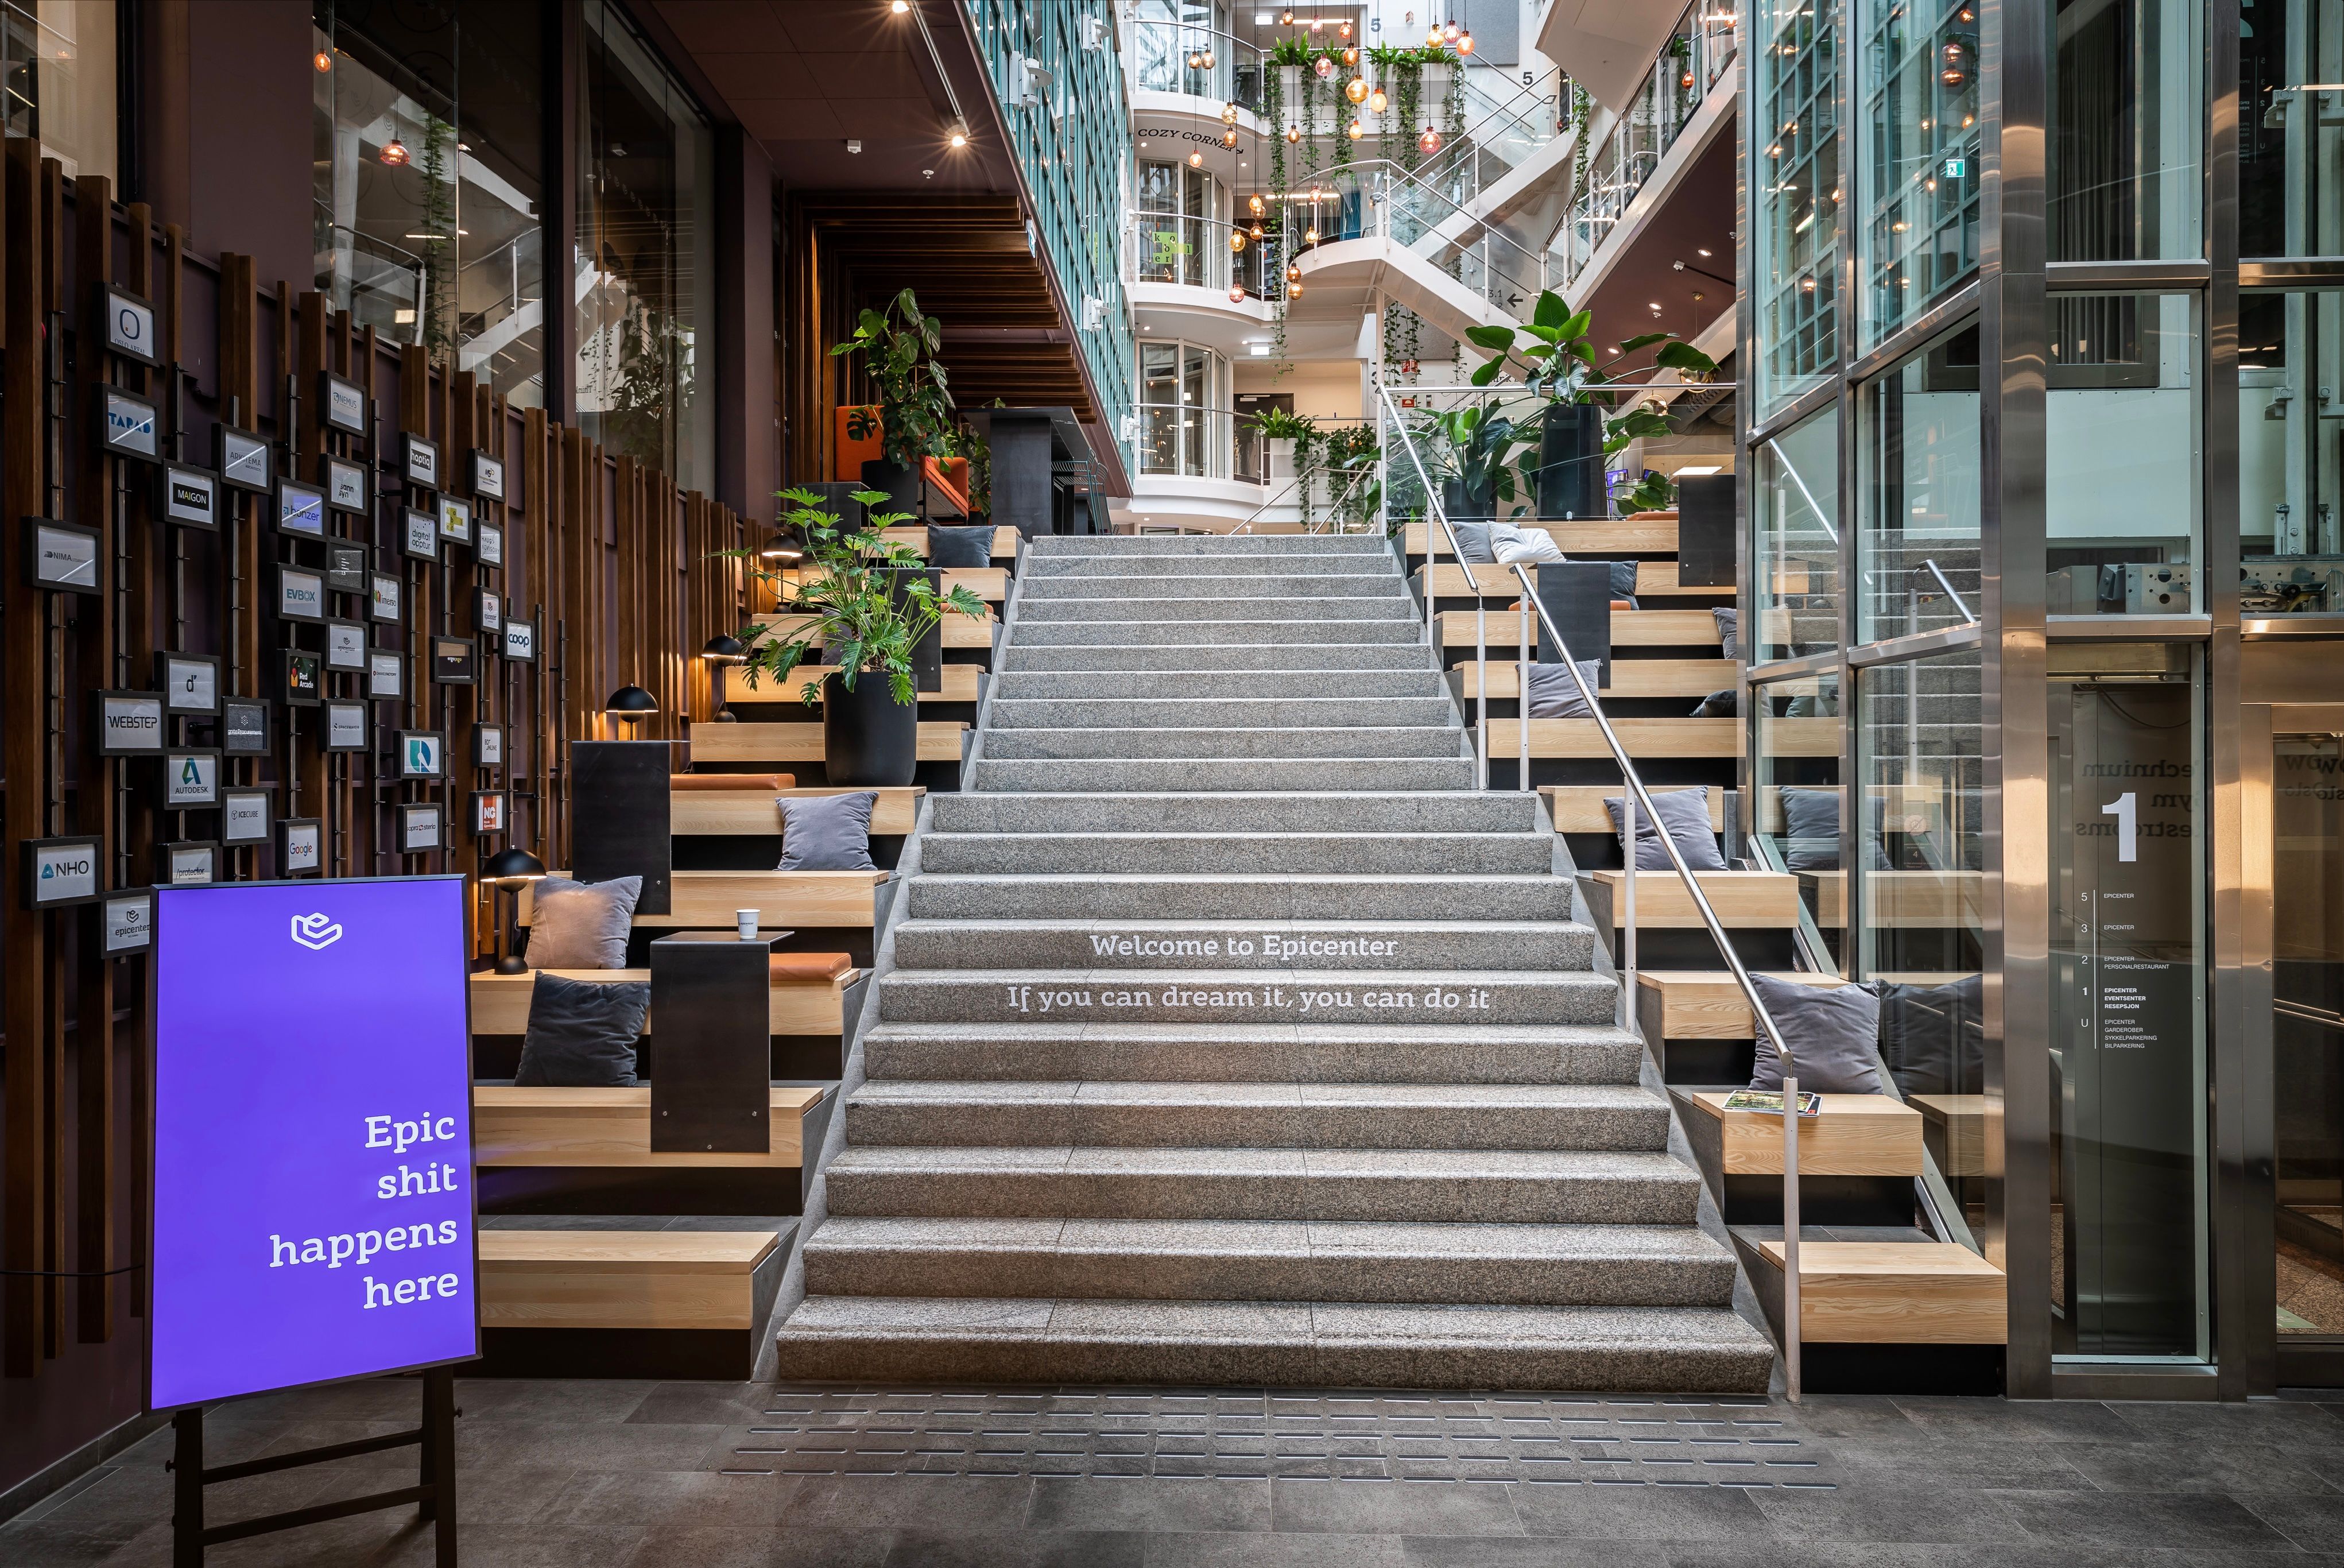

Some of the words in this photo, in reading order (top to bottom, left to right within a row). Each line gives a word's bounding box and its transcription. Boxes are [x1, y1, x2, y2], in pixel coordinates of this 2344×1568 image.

[1371, 18, 1381, 32] 5
[1522, 71, 1533, 86] 5
[1138, 129, 1180, 138] COZY
[1488, 289, 1502, 297] 3.1
[411, 450, 430, 469] haptiq
[338, 490, 349, 498] syn
[340, 483, 354, 493] sann
[177, 489, 207, 504] MAIGON
[290, 505, 320, 521] bonzer
[412, 529, 431, 541] digital
[412, 538, 431, 550] opptur
[286, 587, 316, 602] EVBOX
[508, 633, 530, 648] coop
[299, 672, 308, 680] Red
[299, 680, 313, 688] Arcade
[107, 715, 157, 729] WEBSTEP
[175, 785, 209, 795] AUTODESK
[238, 810, 258, 819] ICECUBE
[483, 806, 496, 819] NG
[2102, 792, 2137, 862] 1
[289, 842, 312, 857] Google
[56, 860, 90, 878] NHO
[2080, 892, 2088, 902] 5
[115, 924, 150, 938] epicenter
[2080, 924, 2088, 933] 3
[1090, 935, 1218, 956] Welcome
[1227, 937, 1254, 956] to
[1262, 935, 1399, 961] Epicenter
[2081, 955, 2088, 965] 2
[2082, 987, 2088, 996] 1
[1008, 986, 1032, 1012] If
[1038, 991, 1092, 1012] you
[1101, 991, 1153, 1006] can
[1162, 986, 1254, 1007] dream
[1263, 986, 1294, 1008] it,
[1299, 992, 1354, 1012] you
[1362, 991, 1415, 1008] can
[1424, 988, 1460, 1008] do
[1468, 988, 1490, 1009] it
[2080, 1019, 2089, 1028] U
[364, 1110, 456, 1154] Epic
[377, 1161, 458, 1201] shit
[269, 1218, 458, 1268] happens
[362, 1272, 459, 1310] here
